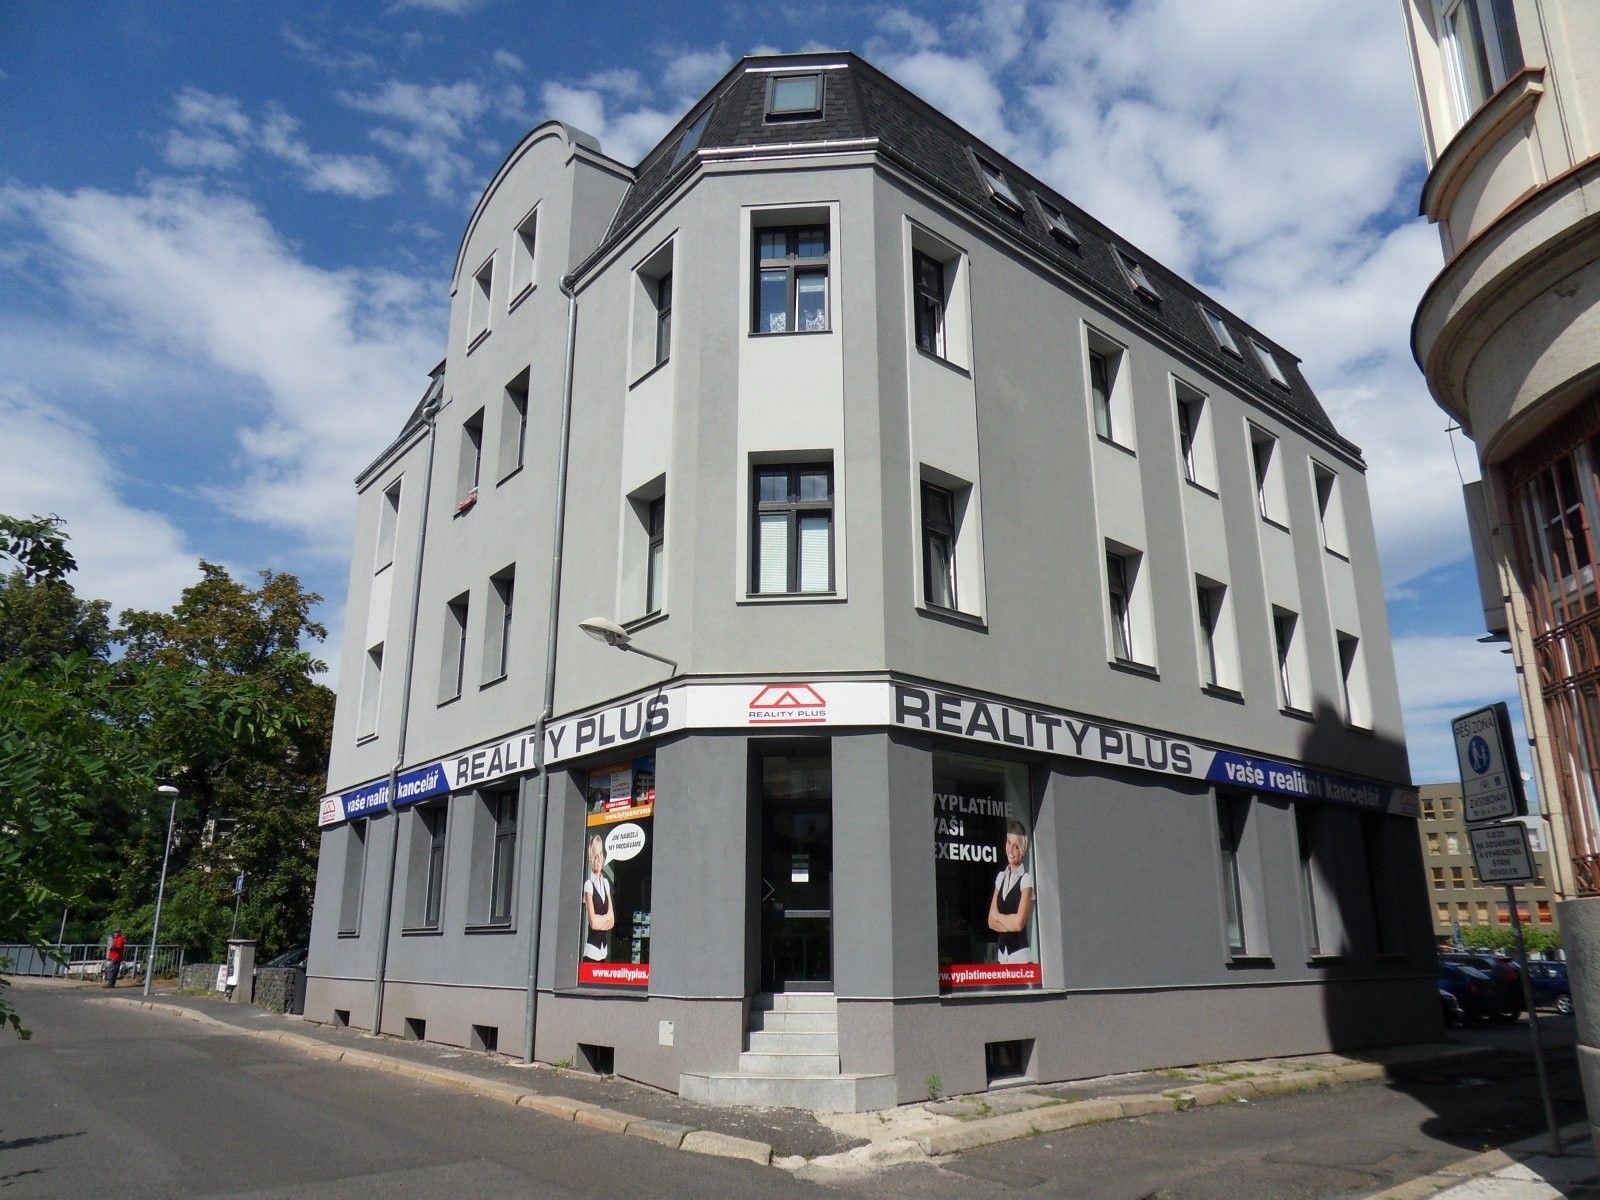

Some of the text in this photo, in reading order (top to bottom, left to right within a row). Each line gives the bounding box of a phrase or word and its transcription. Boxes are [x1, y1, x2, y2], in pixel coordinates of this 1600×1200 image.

[576, 694, 669, 753] PLUS
[895, 685, 1193, 774] REALITY PLUS
[347, 795, 366, 814] vaše
[397, 769, 439, 799] kancelář
[1225, 760, 1265, 785] vaše
[1269, 770, 1321, 798] realitní
[592, 967, 649, 981] www.realityplus.
